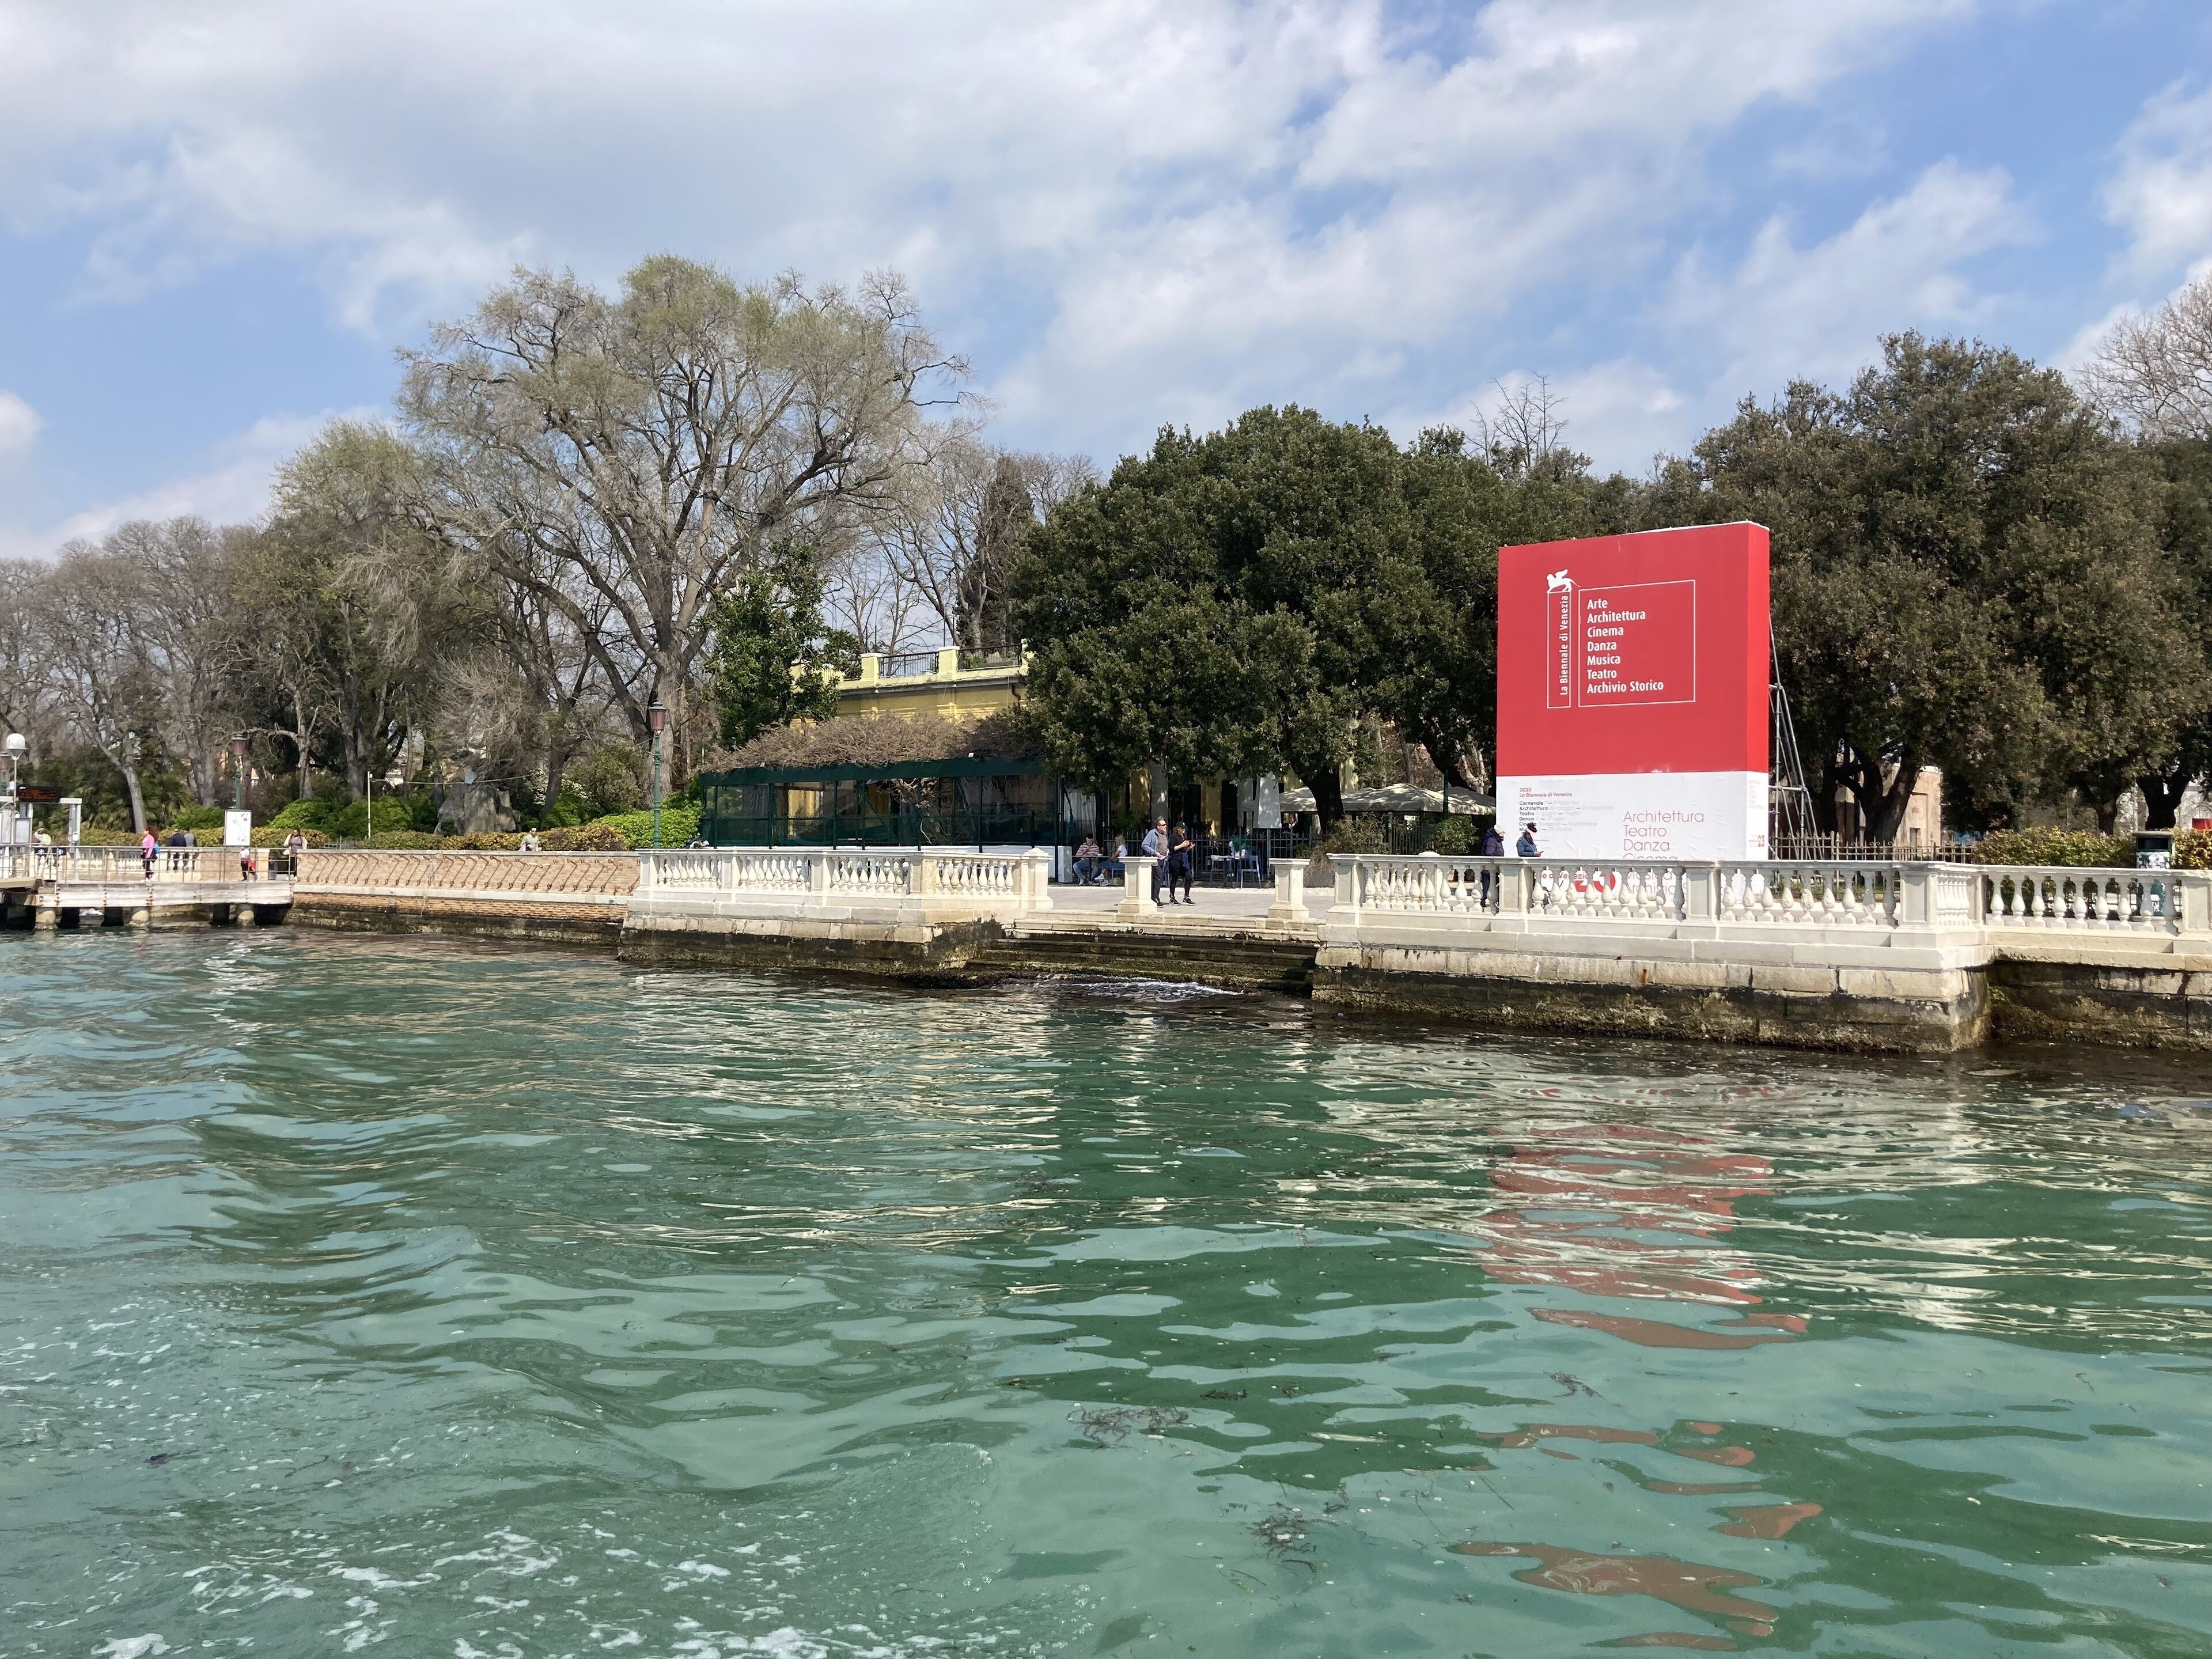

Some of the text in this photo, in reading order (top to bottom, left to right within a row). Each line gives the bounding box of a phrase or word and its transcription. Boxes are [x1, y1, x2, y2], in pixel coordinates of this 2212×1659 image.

[1586, 598, 1608, 609] Arte
[1586, 611, 1646, 624] Architettura
[1587, 626, 1624, 638] Cinema
[1559, 595, 1569, 695] La Biennale di Venezia
[1587, 641, 1617, 652] Danza
[1586, 653, 1621, 666] Musica
[1586, 669, 1617, 680] Teatro
[1586, 680, 1664, 694] Archivio Storico
[1623, 810, 1705, 823] Architettura
[1623, 824, 1666, 837] Teatro
[1623, 839, 1669, 851] Danza
